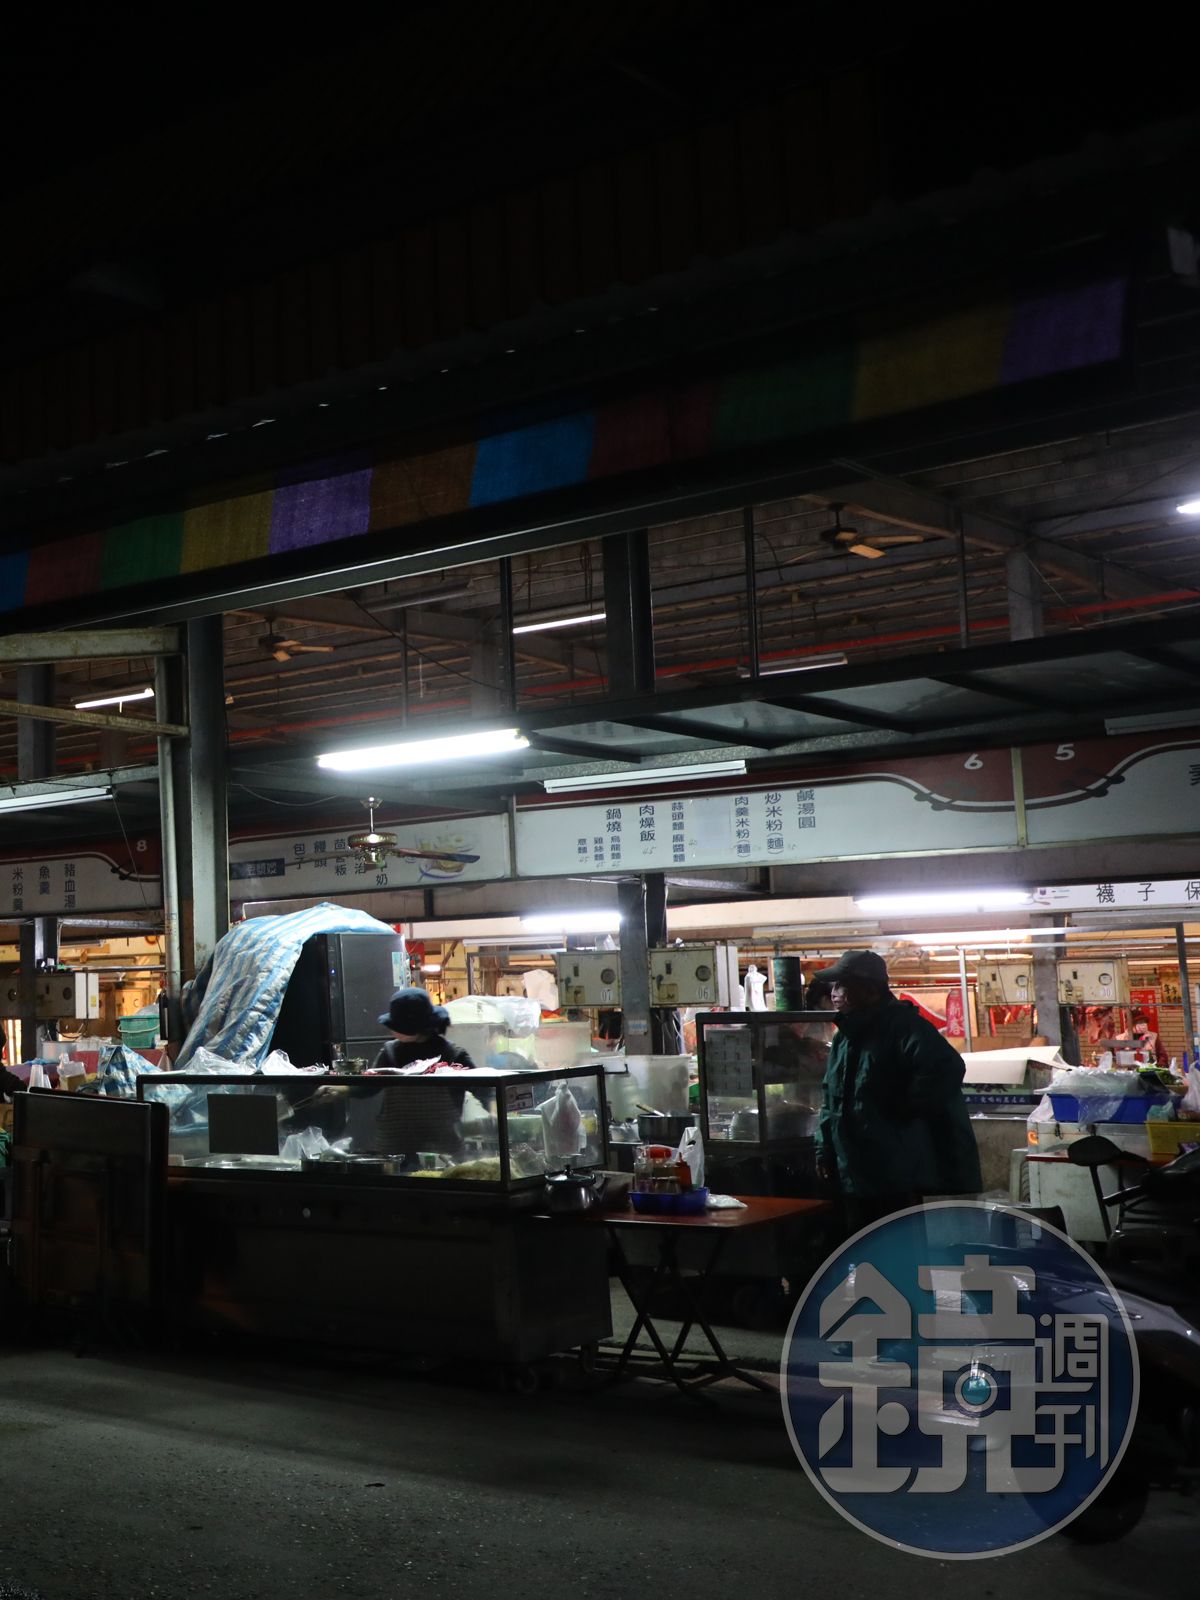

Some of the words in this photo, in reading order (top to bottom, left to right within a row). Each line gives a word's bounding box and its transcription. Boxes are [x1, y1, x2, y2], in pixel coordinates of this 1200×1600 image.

[964, 753, 983, 770] 6
[1054, 743, 1075, 761] 5
[606, 808, 622, 832] 鍋燒
[796, 789, 816, 829] 鹹湯圓
[639, 805, 655, 842] 肉燥飯
[136, 840, 148, 852] 8
[293, 843, 306, 870] 包子
[64, 863, 76, 908] 豬血湯
